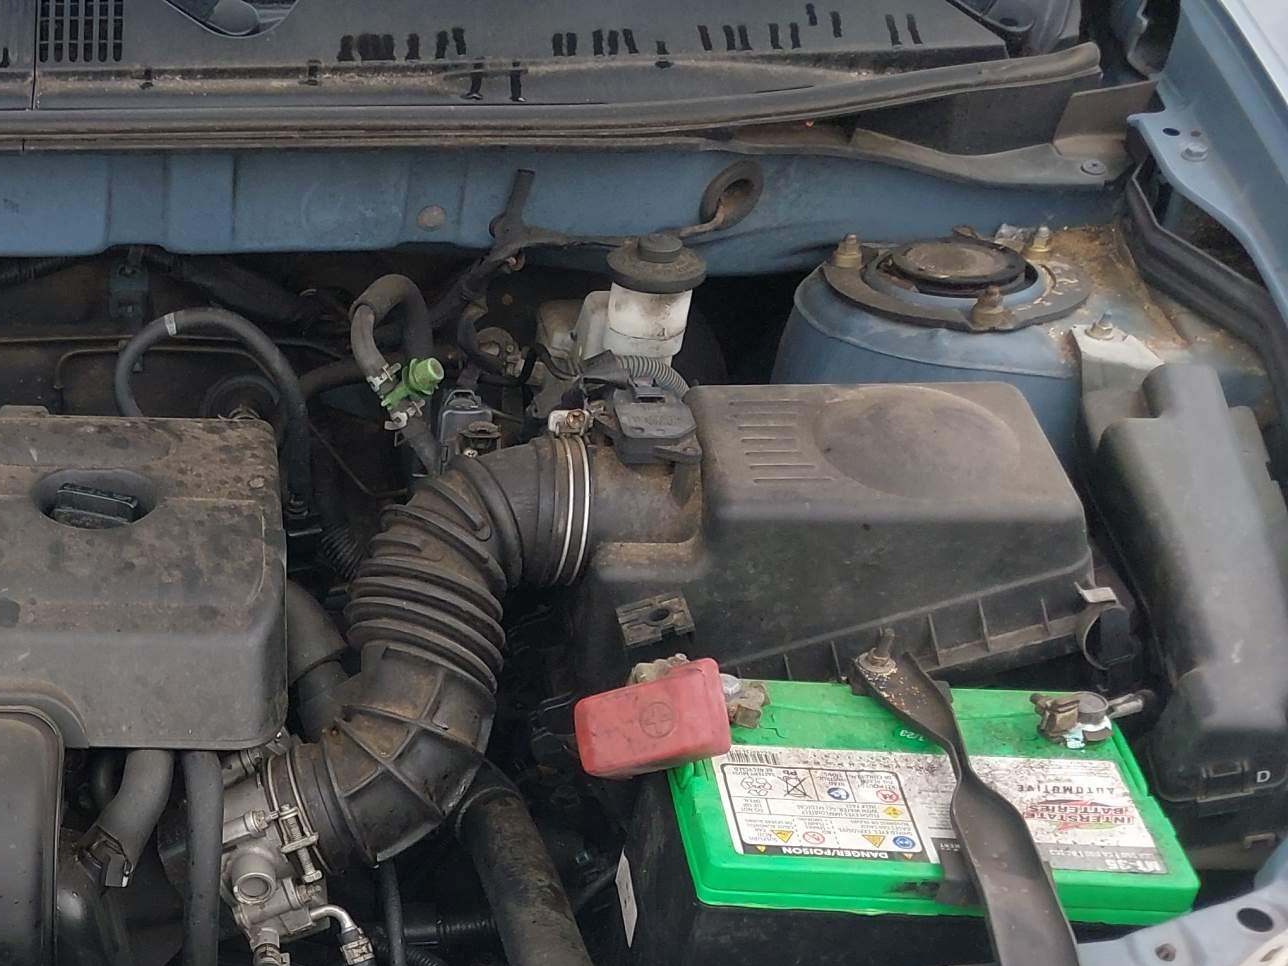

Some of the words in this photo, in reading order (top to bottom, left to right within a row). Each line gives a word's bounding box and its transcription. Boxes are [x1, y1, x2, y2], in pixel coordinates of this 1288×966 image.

[1256, 769, 1272, 783] D
[1016, 784, 1115, 795] AUTOMOTIVE
[1027, 804, 1129, 815] BATTERIES
[1023, 811, 1134, 824] INTERSTATE
[781, 847, 889, 859] DANGER/POISON
